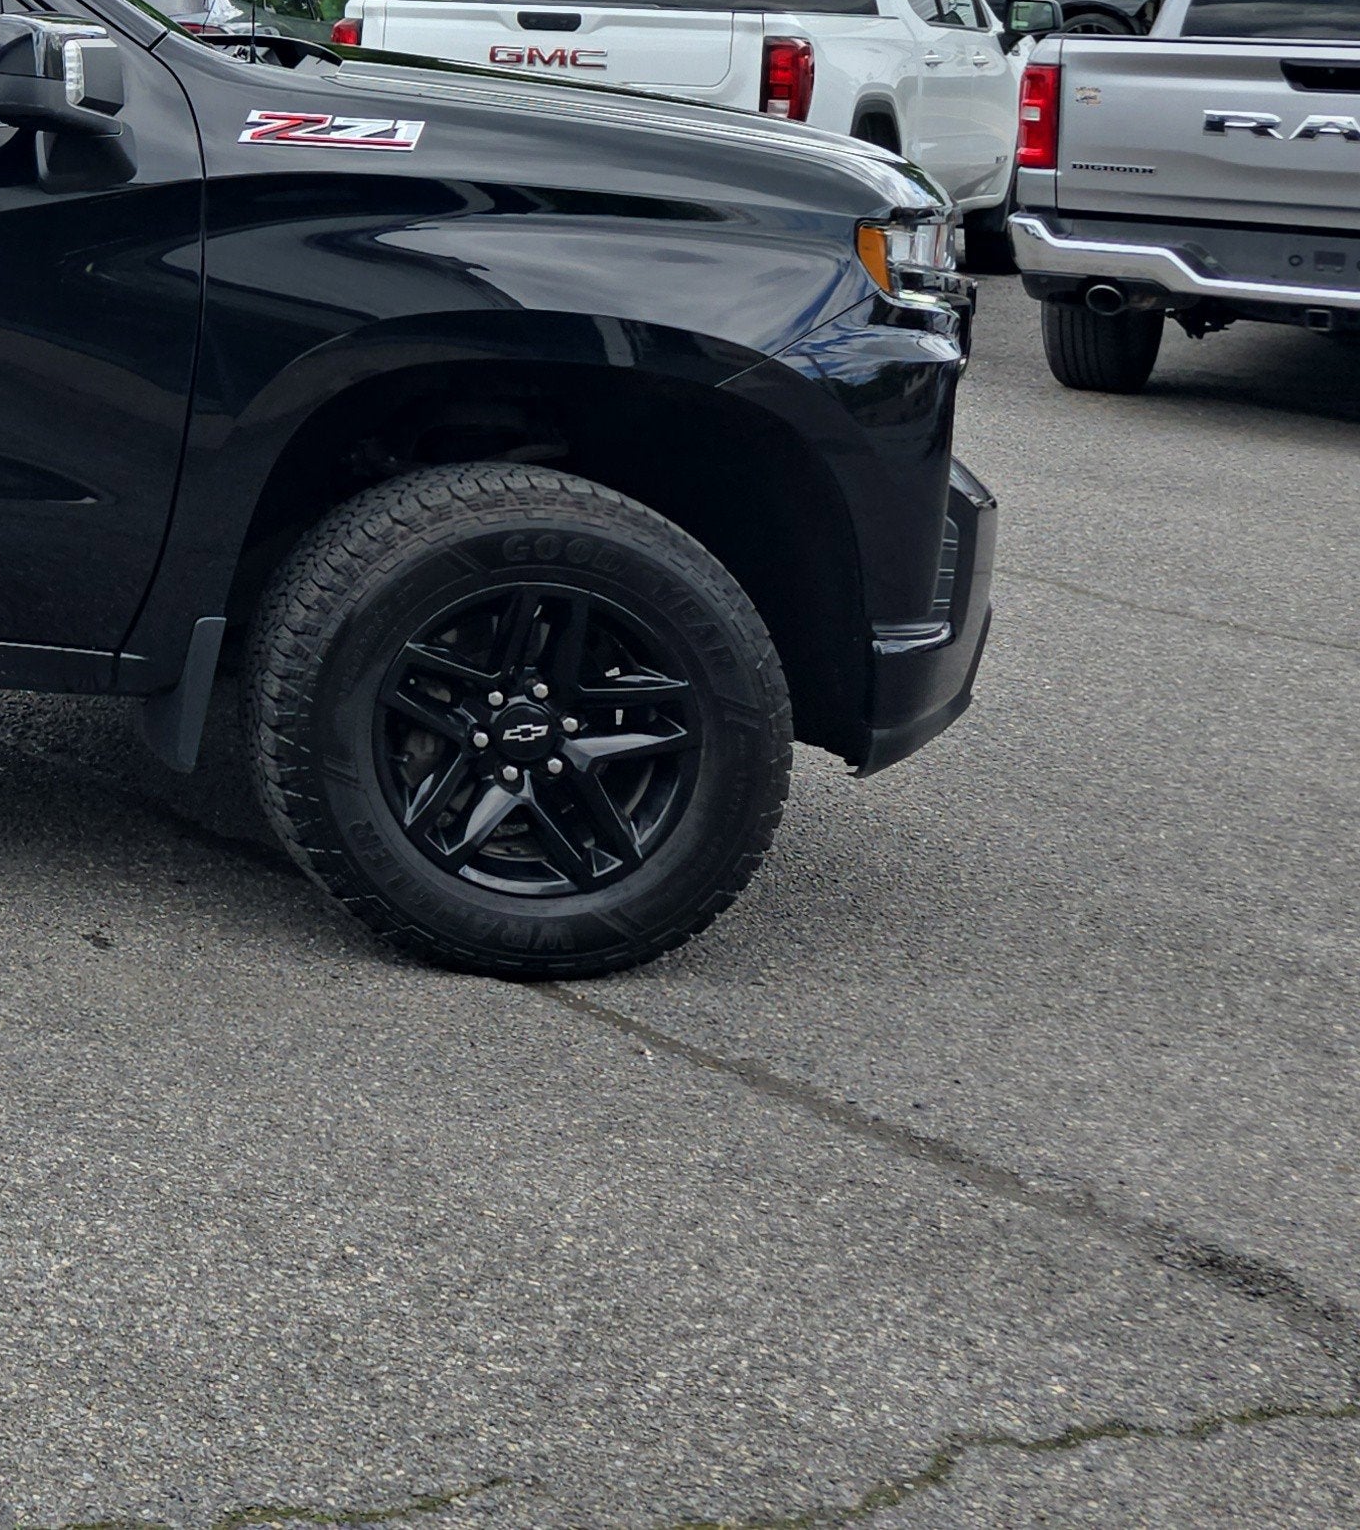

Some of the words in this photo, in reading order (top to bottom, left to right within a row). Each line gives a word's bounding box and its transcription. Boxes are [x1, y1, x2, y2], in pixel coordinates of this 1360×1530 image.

[488, 44, 608, 70] GMC
[237, 109, 426, 153] Z71
[349, 820, 577, 950] WRANGLER
